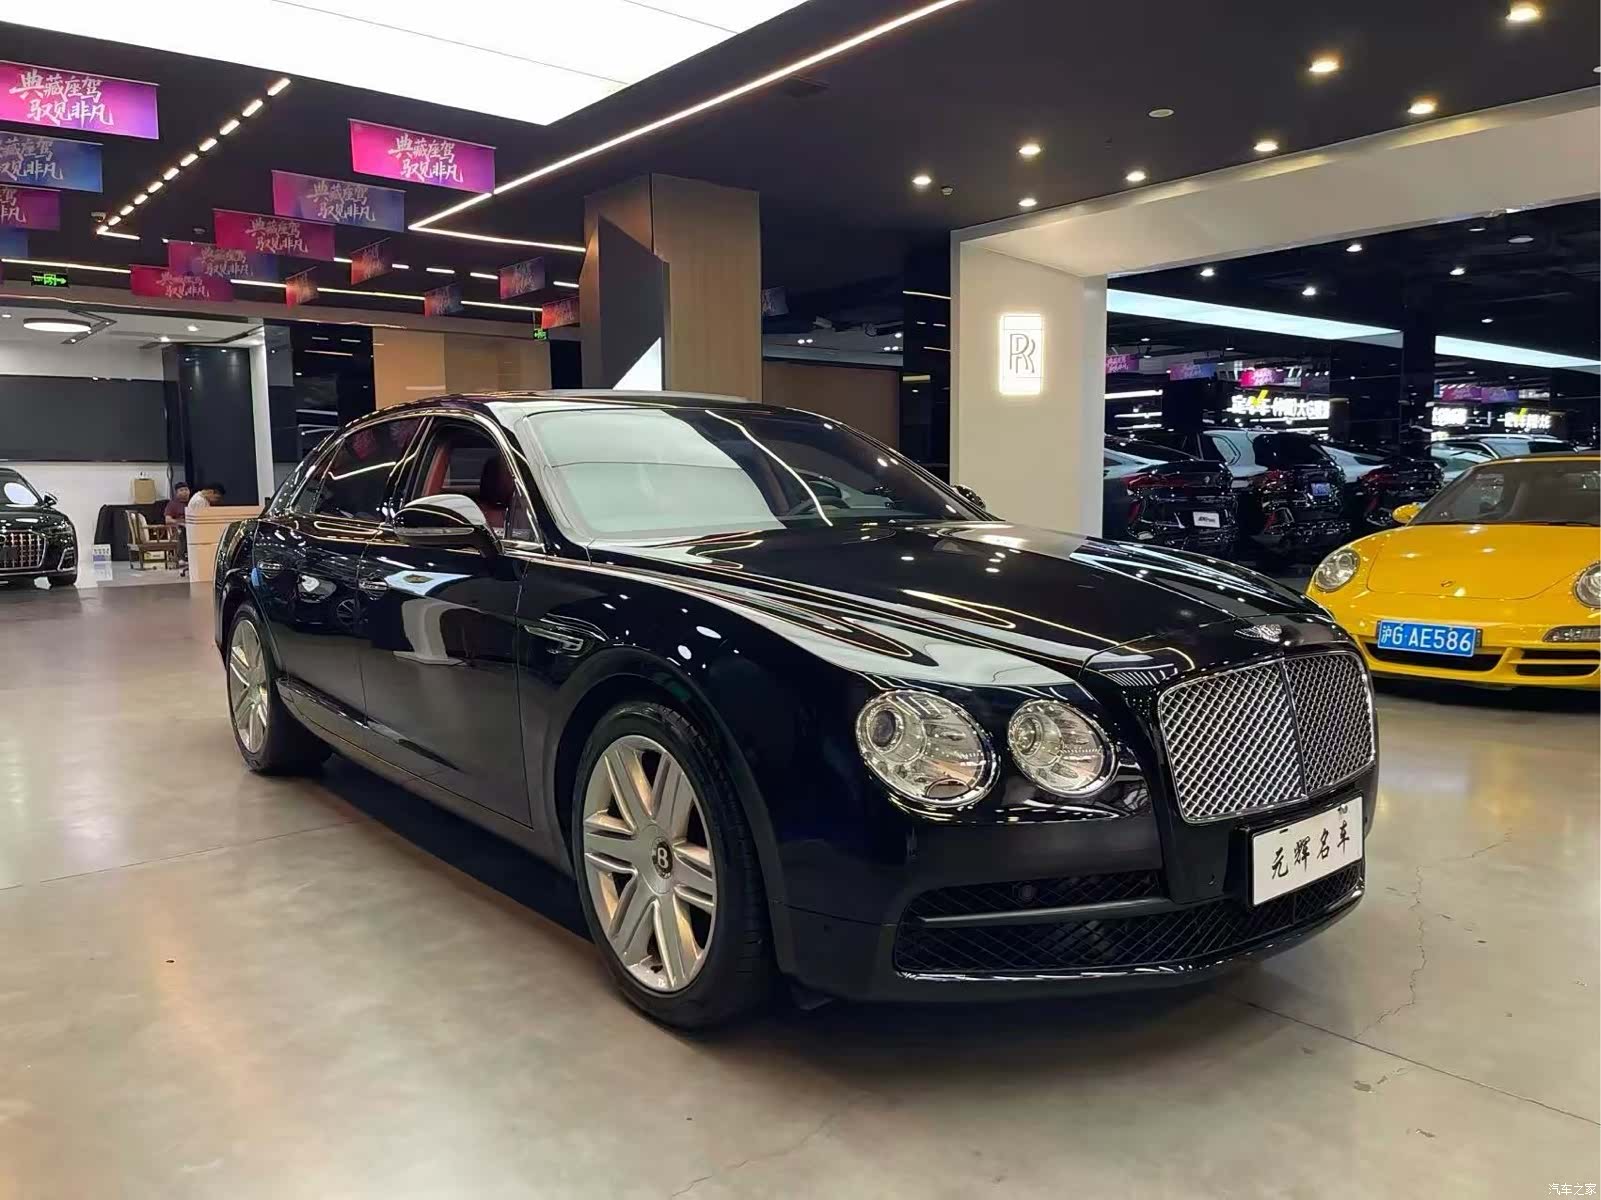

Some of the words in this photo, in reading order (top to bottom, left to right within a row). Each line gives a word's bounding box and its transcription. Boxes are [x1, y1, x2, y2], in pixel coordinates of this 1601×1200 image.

[9, 68, 103, 103] 典藏座驾
[27, 99, 114, 127] 驭见非凡
[388, 133, 456, 163] 典藏座驾
[400, 159, 464, 183] 驭见非凡
[306, 180, 368, 206] 典藏座驾
[317, 202, 376, 222] 驭见非凡
[1271, 819, 1350, 880] 元辉名车
